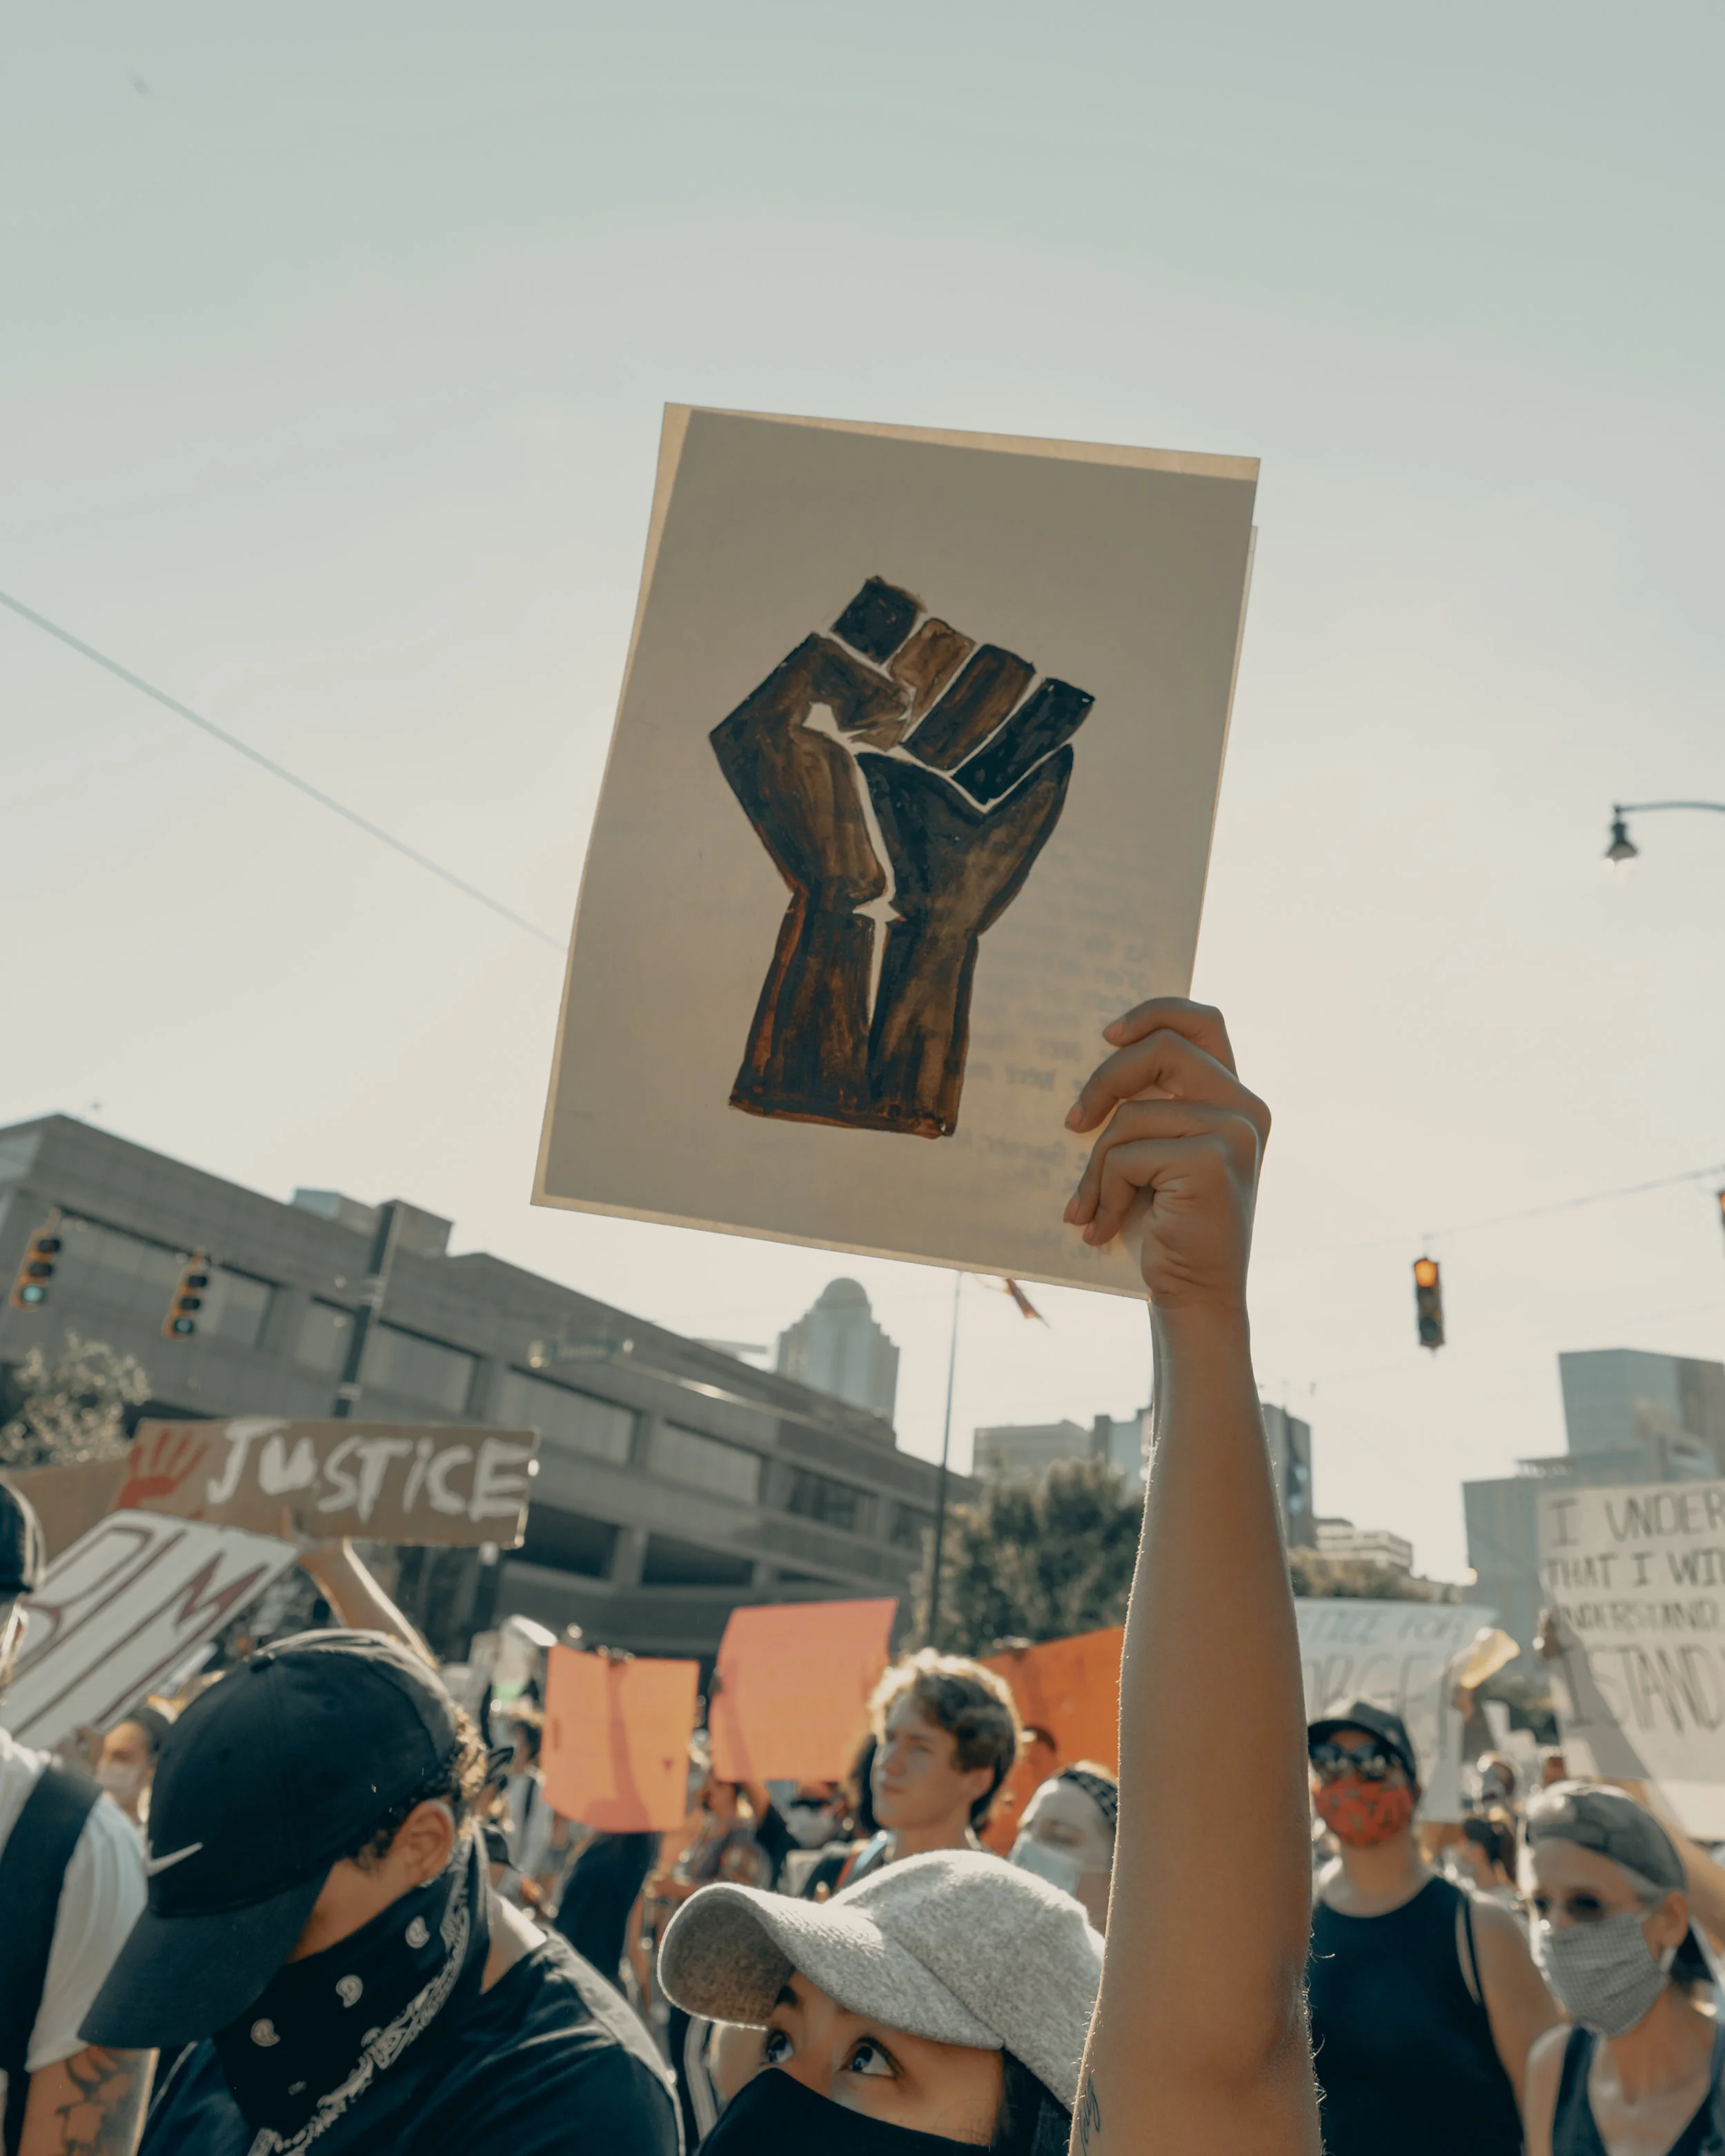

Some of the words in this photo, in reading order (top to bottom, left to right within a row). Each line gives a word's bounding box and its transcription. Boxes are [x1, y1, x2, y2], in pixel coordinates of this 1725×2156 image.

[208, 1414, 534, 1523] JUSTICE
[1548, 1497, 1579, 1547] I
[1544, 1551, 1619, 1590] THAT
[1630, 1551, 1655, 1588] I
